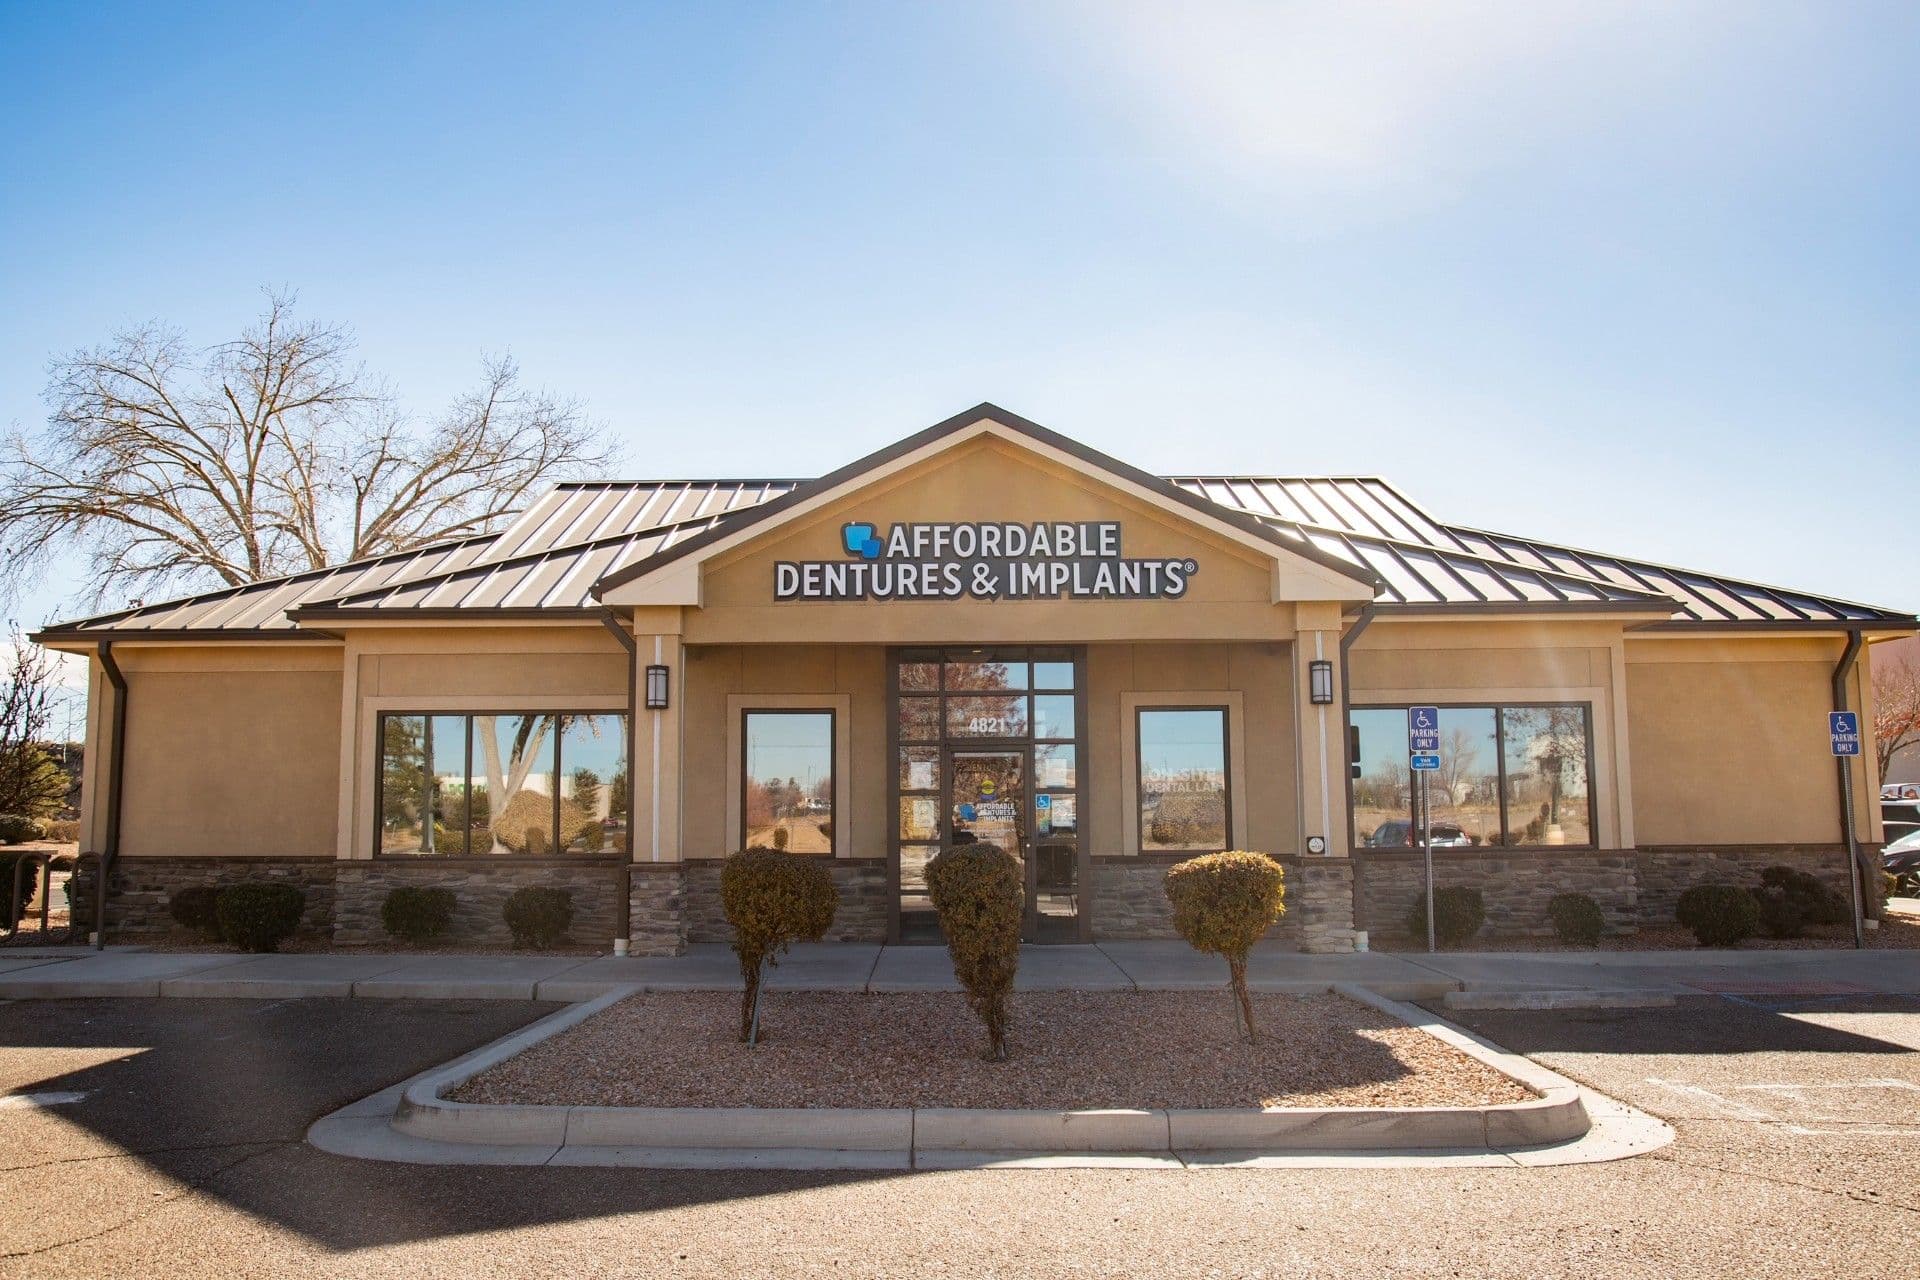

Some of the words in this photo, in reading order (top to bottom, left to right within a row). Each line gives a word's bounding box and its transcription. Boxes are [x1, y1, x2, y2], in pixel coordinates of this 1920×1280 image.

[886, 524, 1118, 558] AFFORDABLE
[777, 562, 962, 596] DENTURES
[971, 562, 998, 595] &
[969, 717, 1005, 732] 4821
[1411, 729, 1439, 738] PARKING
[1832, 733, 1858, 742] PARKING
[1416, 738, 1433, 748] ONLY
[1837, 743, 1853, 752] ONLY
[1146, 782, 1192, 793] DENTAL
